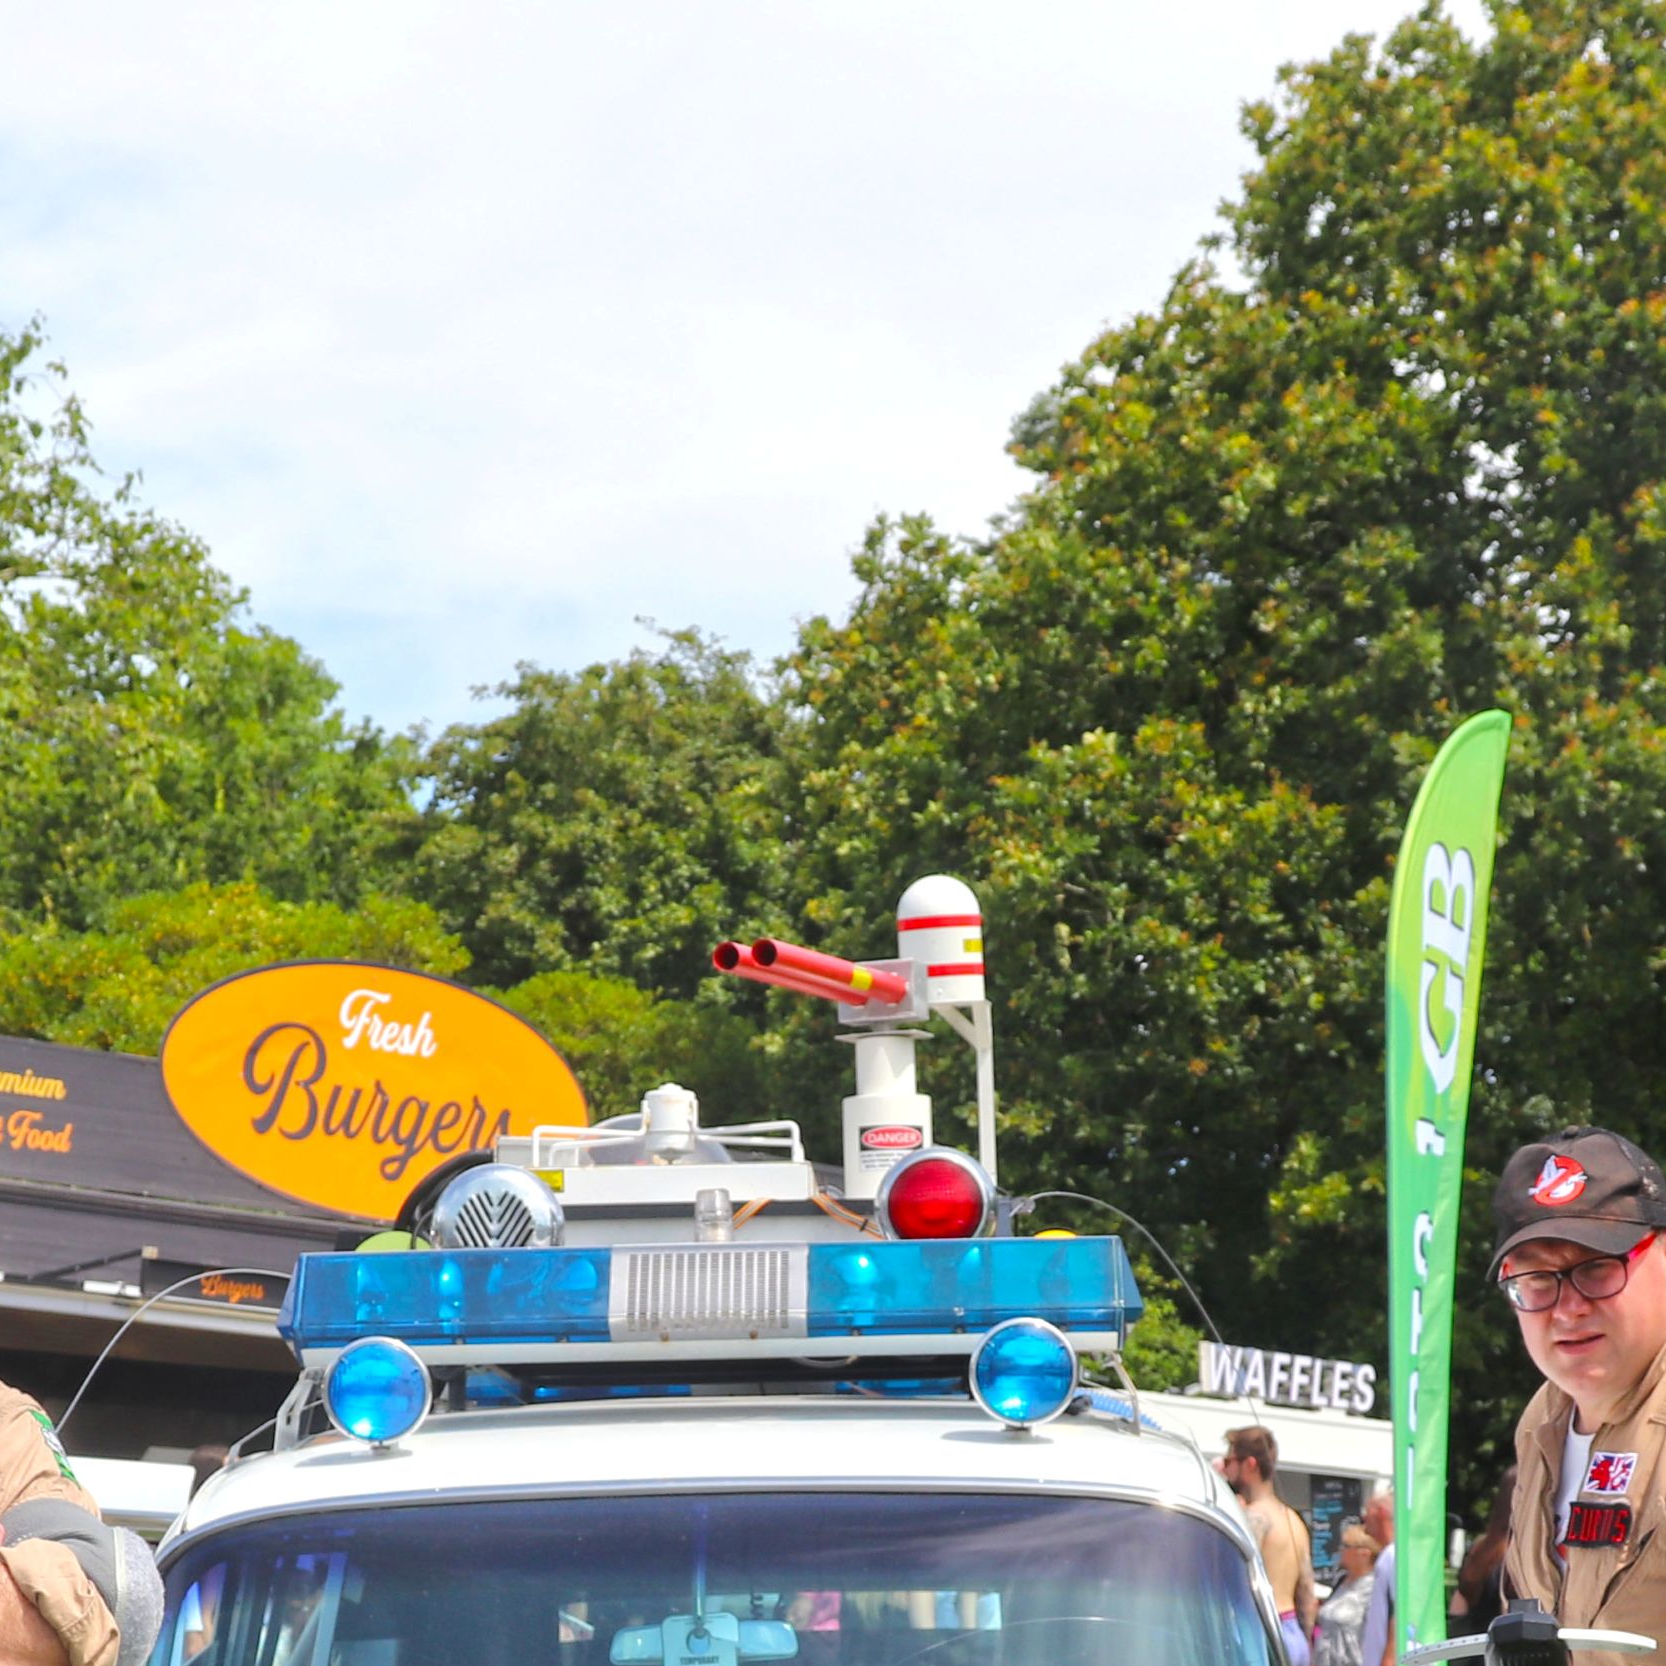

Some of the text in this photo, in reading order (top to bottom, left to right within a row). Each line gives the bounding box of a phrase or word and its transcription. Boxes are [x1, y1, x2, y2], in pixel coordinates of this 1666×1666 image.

[339, 989, 438, 1058] Fresh
[7, 1109, 73, 1153] Food
[242, 1021, 511, 1182] Burgers
[867, 1131, 919, 1144] DANGER
[1209, 1343, 1377, 1413] WAFFLES
